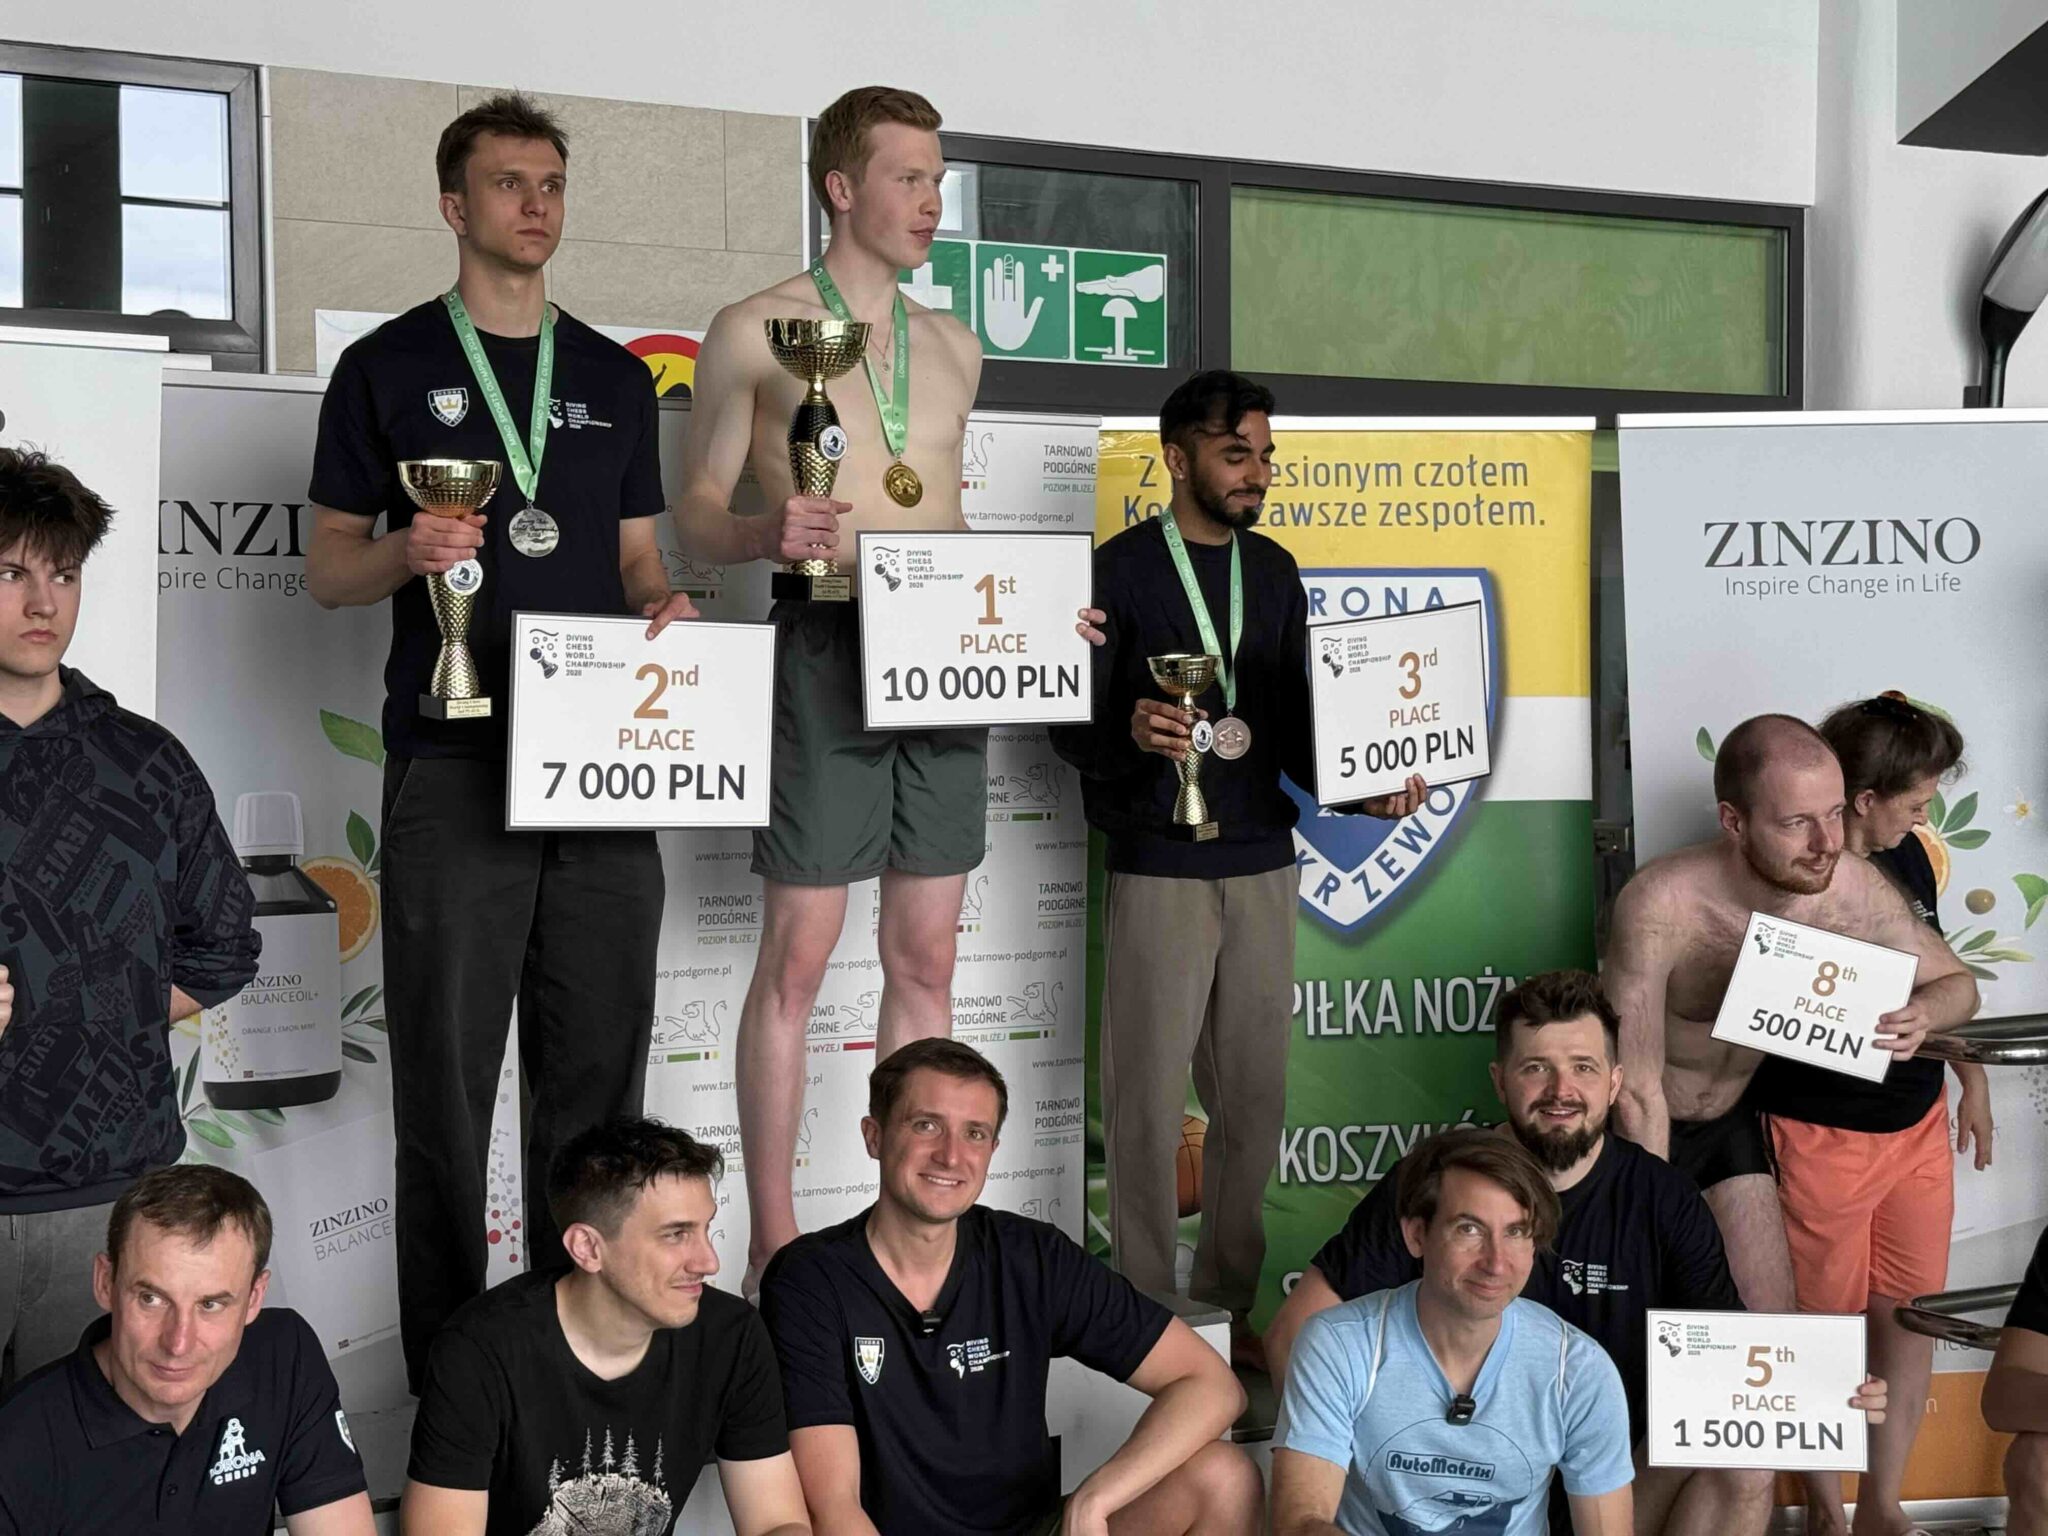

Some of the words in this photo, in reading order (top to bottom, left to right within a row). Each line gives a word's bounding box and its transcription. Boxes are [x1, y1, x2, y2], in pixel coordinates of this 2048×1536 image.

[472, 351, 495, 392] OLYMPIAD
[537, 378, 547, 407] SPORTS
[489, 392, 508, 423] SPORTS
[535, 409, 544, 430] MIND
[502, 423, 517, 446] MIND
[1043, 444, 1092, 457] TARNOWO
[1043, 460, 1096, 474] PODGÓRNE
[1139, 456, 1157, 487] Z
[1414, 454, 1528, 487] czołem
[1378, 495, 1546, 532] zespołem.
[1704, 517, 1981, 568] ZINZINO
[908, 573, 964, 581] CHAMPIONSHIP
[1725, 576, 1799, 600] Inspire
[1807, 575, 1888, 599] Change
[1896, 574, 1915, 593] in
[1922, 573, 1961, 593] Life
[974, 574, 1016, 625] 1st
[565, 634, 594, 642] DIVING
[565, 643, 593, 651] CHESS
[960, 634, 1027, 654] PLACE
[1347, 636, 1368, 644] DIVING
[1347, 644, 1368, 652] CHESS
[565, 652, 595, 660] WORLD
[565, 660, 626, 669] CHAMPIONSHIP
[1347, 651, 1369, 659] WORLD
[882, 666, 928, 701] 10
[939, 665, 1006, 700] 000
[1017, 664, 1079, 699] PLN
[1398, 648, 1438, 699] 3rd
[633, 663, 699, 719] 2nd
[1389, 702, 1440, 729] PLACE
[618, 728, 695, 751] PLACE
[1340, 746, 1356, 778] 5
[1365, 737, 1417, 774] 000
[1426, 725, 1474, 764] PLN
[542, 762, 567, 799] 7
[579, 762, 655, 800] 000
[669, 764, 745, 800] PLN
[1039, 882, 1083, 895] TARNOWO
[698, 894, 752, 908] TARNOWO
[1038, 896, 1085, 911] PODGÓRNE
[698, 909, 758, 926] PODGÓRNE
[697, 935, 727, 945] POZIOM
[1812, 960, 1858, 997] 8th
[952, 995, 1002, 1008] TARNOWO
[1794, 996, 1847, 1022] PLACE
[242, 1027, 271, 1035] ORANGE
[1749, 1008, 1802, 1041] 500
[1805, 1023, 1864, 1059] PLN
[1035, 1097, 1080, 1112] TARNOWO
[1034, 1112, 1083, 1128] PODGÓRNE
[309, 1198, 388, 1237] ZINZINO
[315, 1219, 393, 1261] BALANCE
[1745, 1346, 1795, 1388] 5th
[1732, 1394, 1796, 1412] PLACE
[1673, 1419, 1691, 1447] 1
[1703, 1420, 1765, 1448] 500
[1776, 1421, 1843, 1451] PLN
[1390, 1453, 1491, 1478] AutoMatrix
